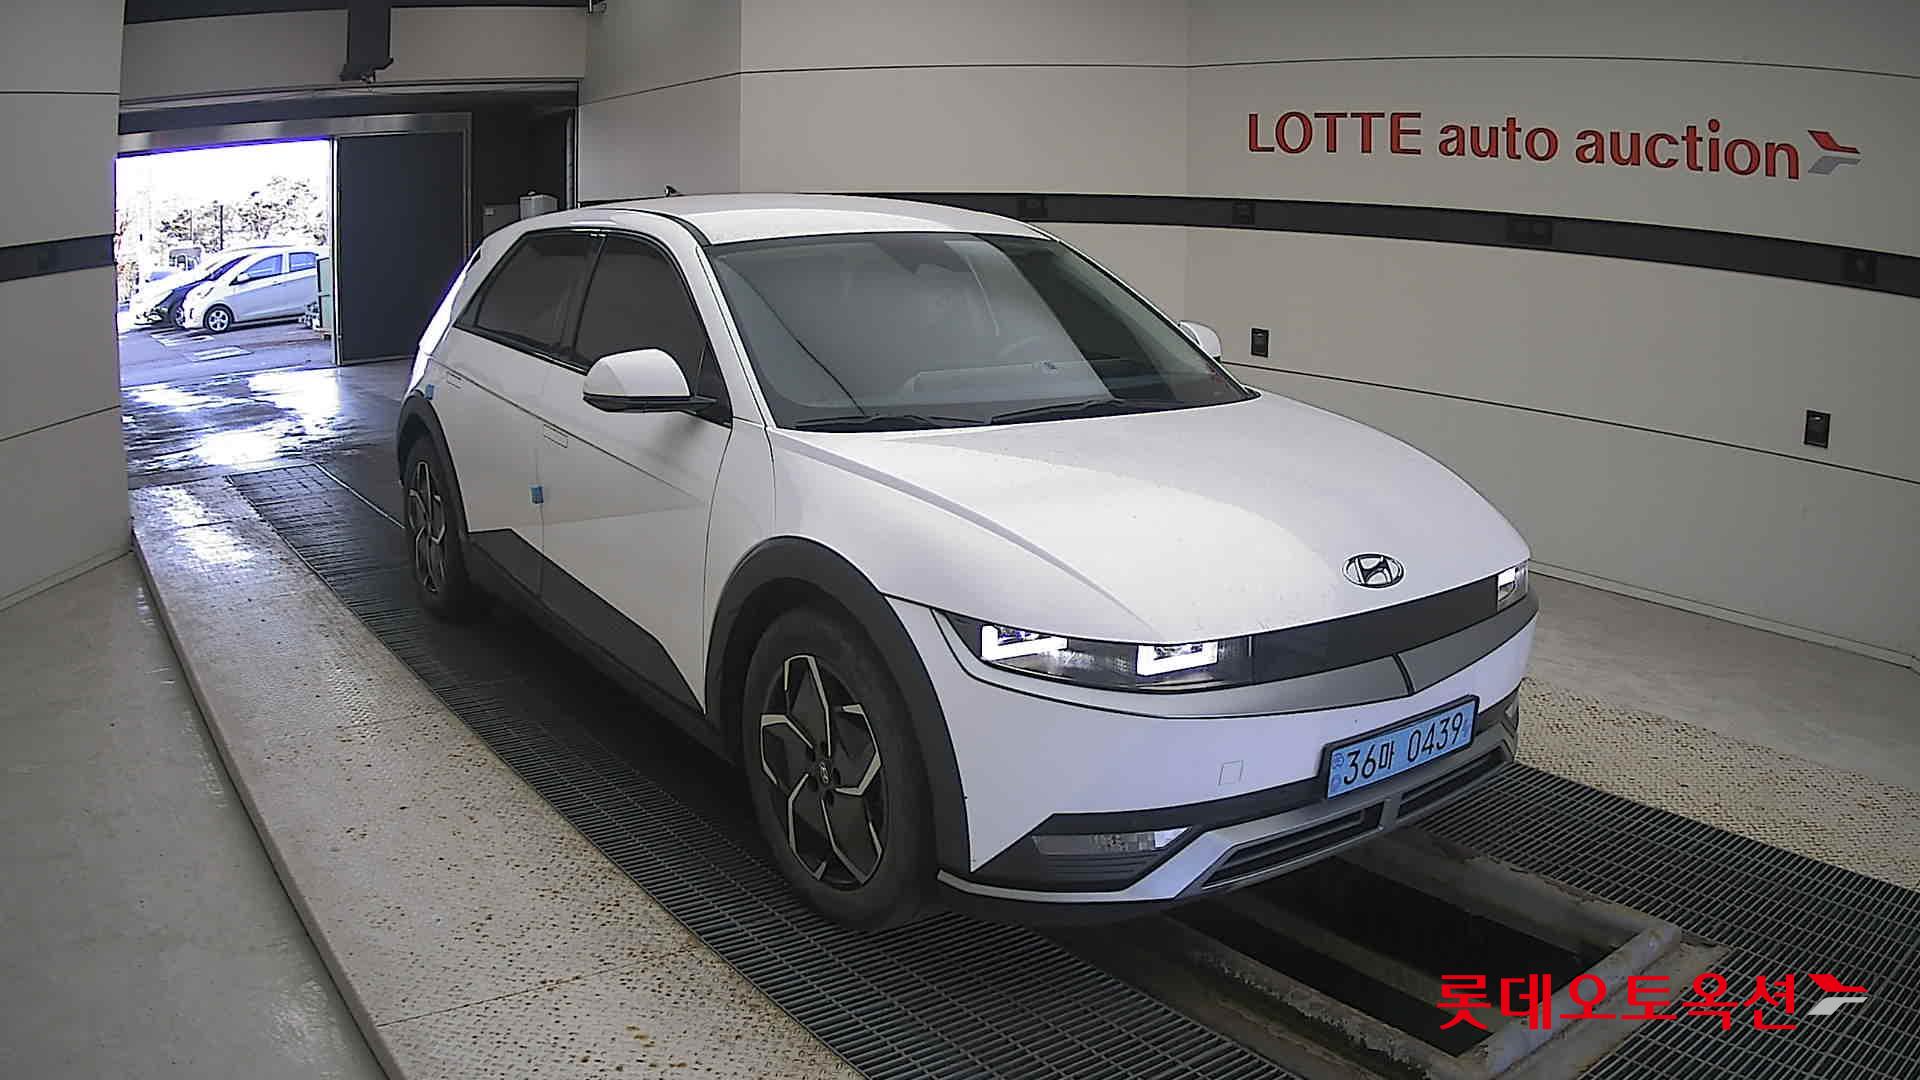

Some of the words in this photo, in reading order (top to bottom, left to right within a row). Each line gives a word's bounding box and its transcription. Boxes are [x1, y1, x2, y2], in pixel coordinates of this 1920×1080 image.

[1248, 112, 1422, 155] LOTTE
[1439, 117, 1559, 162] auto
[1575, 119, 1800, 180] auction
[1343, 740, 1395, 785] 36마
[1407, 712, 1464, 763] 0439
